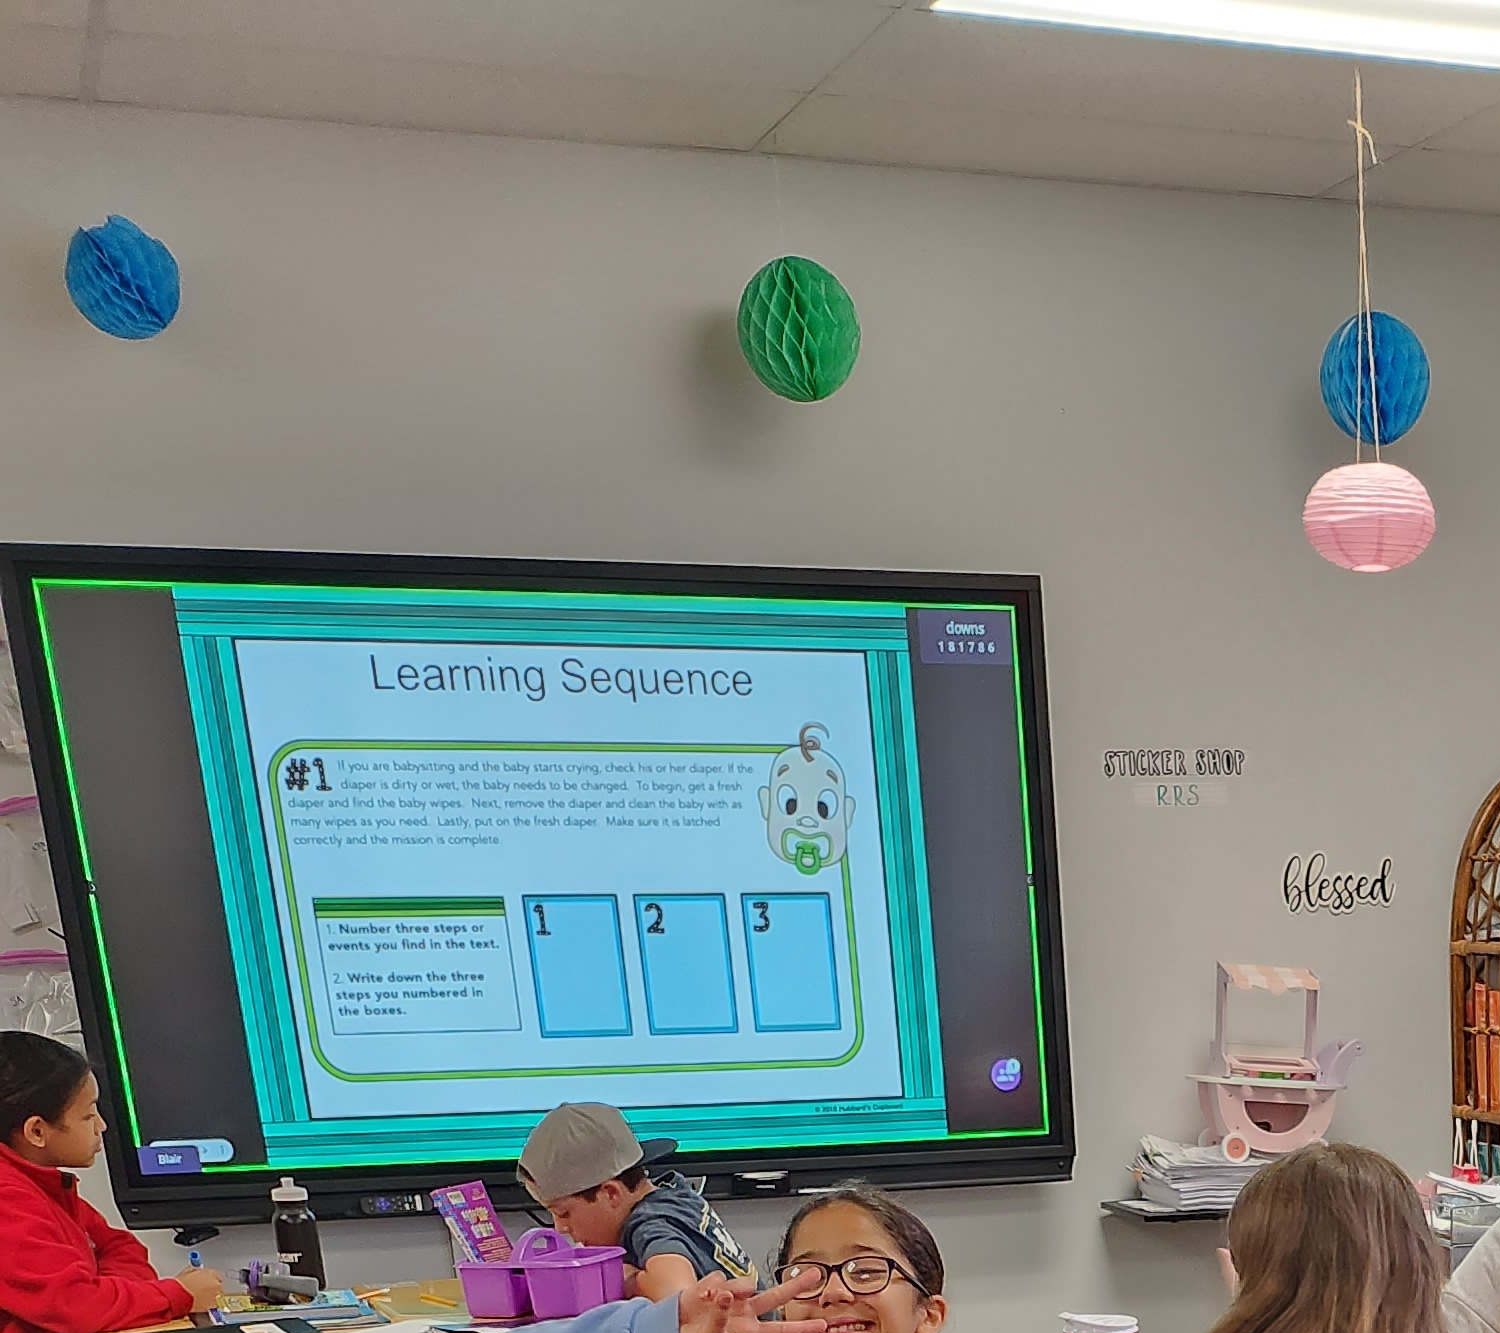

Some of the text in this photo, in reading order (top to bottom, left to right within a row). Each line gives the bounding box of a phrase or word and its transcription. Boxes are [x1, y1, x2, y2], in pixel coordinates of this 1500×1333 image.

[945, 621, 985, 635] downs
[369, 654, 753, 702] Learning Sequence
[337, 760, 754, 777] If you are babysitting and the baby starts crying, check his or her diaper. If the
[1104, 750, 1246, 777] STICKER SHOP
[284, 757, 332, 791] #1
[341, 778, 742, 794] diaper is dirty or wet, the baby needs to be changed. To begin, get a fresh
[287, 797, 743, 812] diaper and find the baby wipes. Next, remove the diaper and clean the baby with as
[291, 816, 721, 830] many wipes as you need. Lastly, put on the fresh diaper. Make sure it is latched
[293, 834, 342, 848] correctly
[346, 834, 367, 845] and
[370, 834, 389, 845] the
[391, 834, 433, 845] mission
[436, 834, 445, 845] is
[1283, 853, 1394, 911] blessed
[532, 904, 551, 935] 1
[644, 903, 665, 934] 2
[752, 901, 770, 932] 3
[326, 922, 484, 936] 1. Number three steps or
[328, 938, 500, 953] events you find in the text.
[333, 970, 485, 984] 2. Write down the three
[335, 986, 484, 1002] steps you numbered in
[338, 1004, 407, 1016] the boxes.
[157, 1154, 182, 1165] Blair
